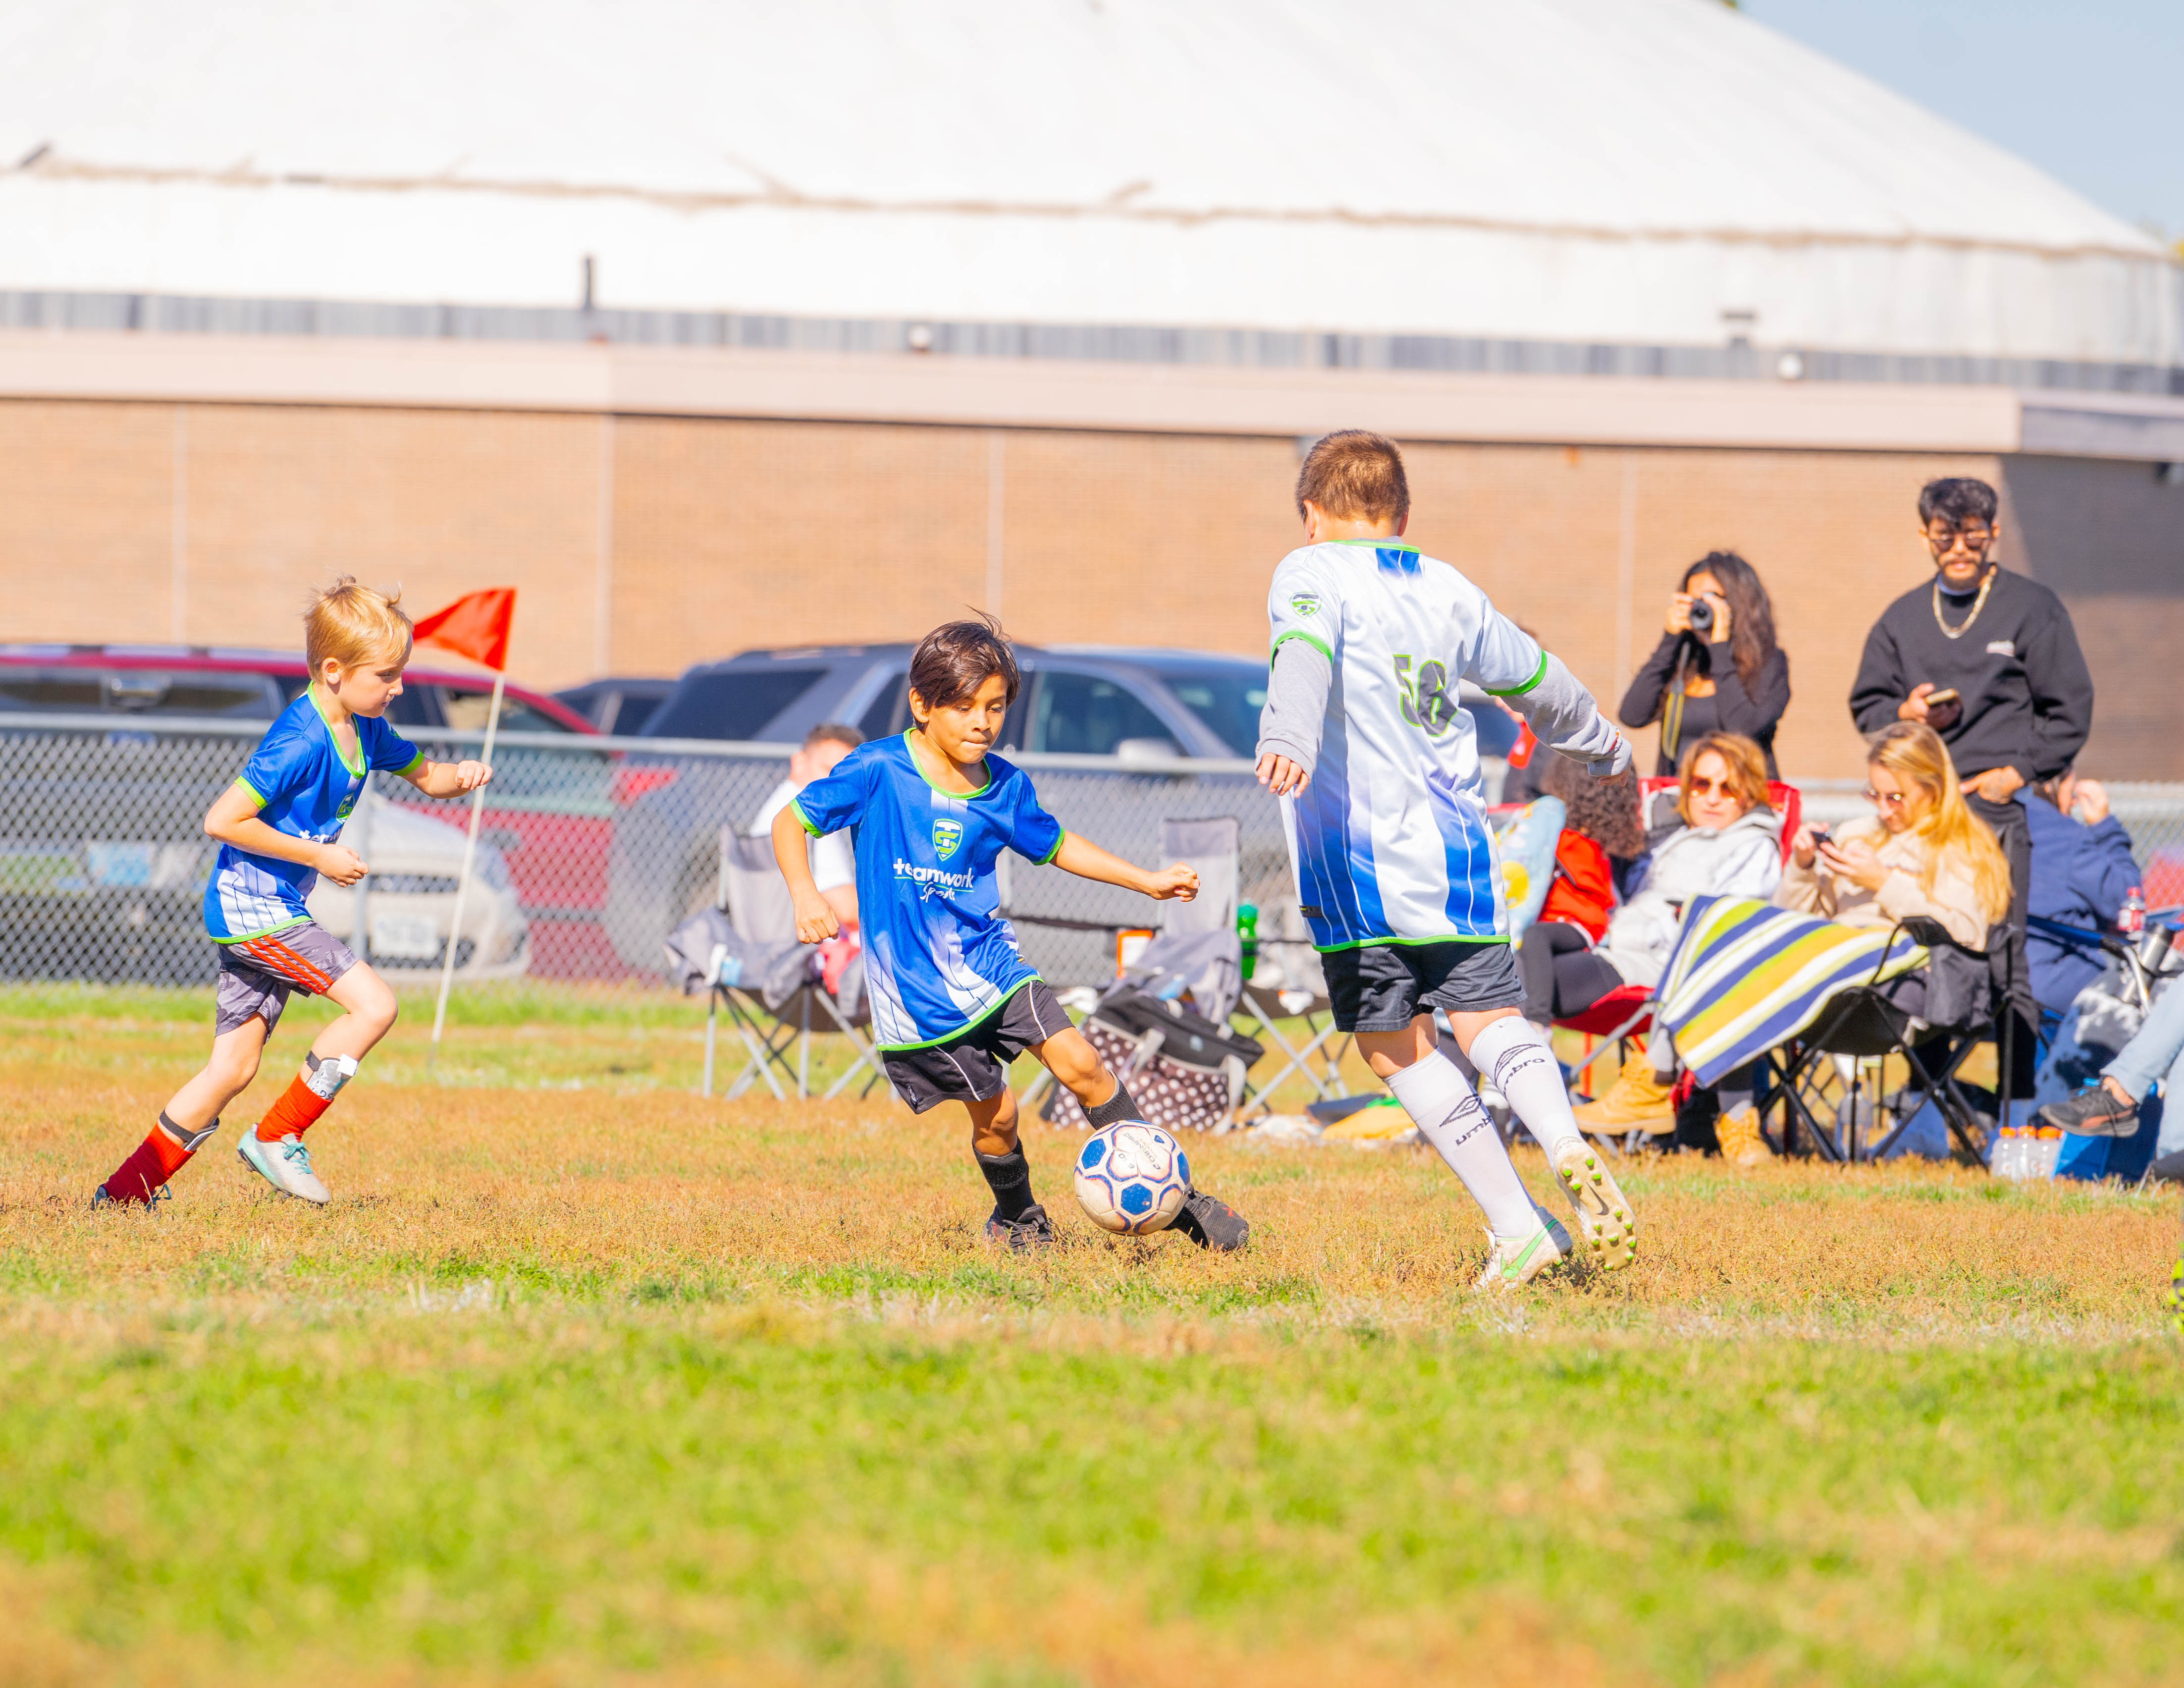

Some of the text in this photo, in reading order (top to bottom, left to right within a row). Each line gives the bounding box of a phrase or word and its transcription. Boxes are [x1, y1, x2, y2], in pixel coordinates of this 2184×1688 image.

[1392, 654, 1458, 737] 56
[893, 858, 974, 888] teamwork
[919, 881, 956, 903] Sports
[1455, 1116, 1492, 1145] umb
